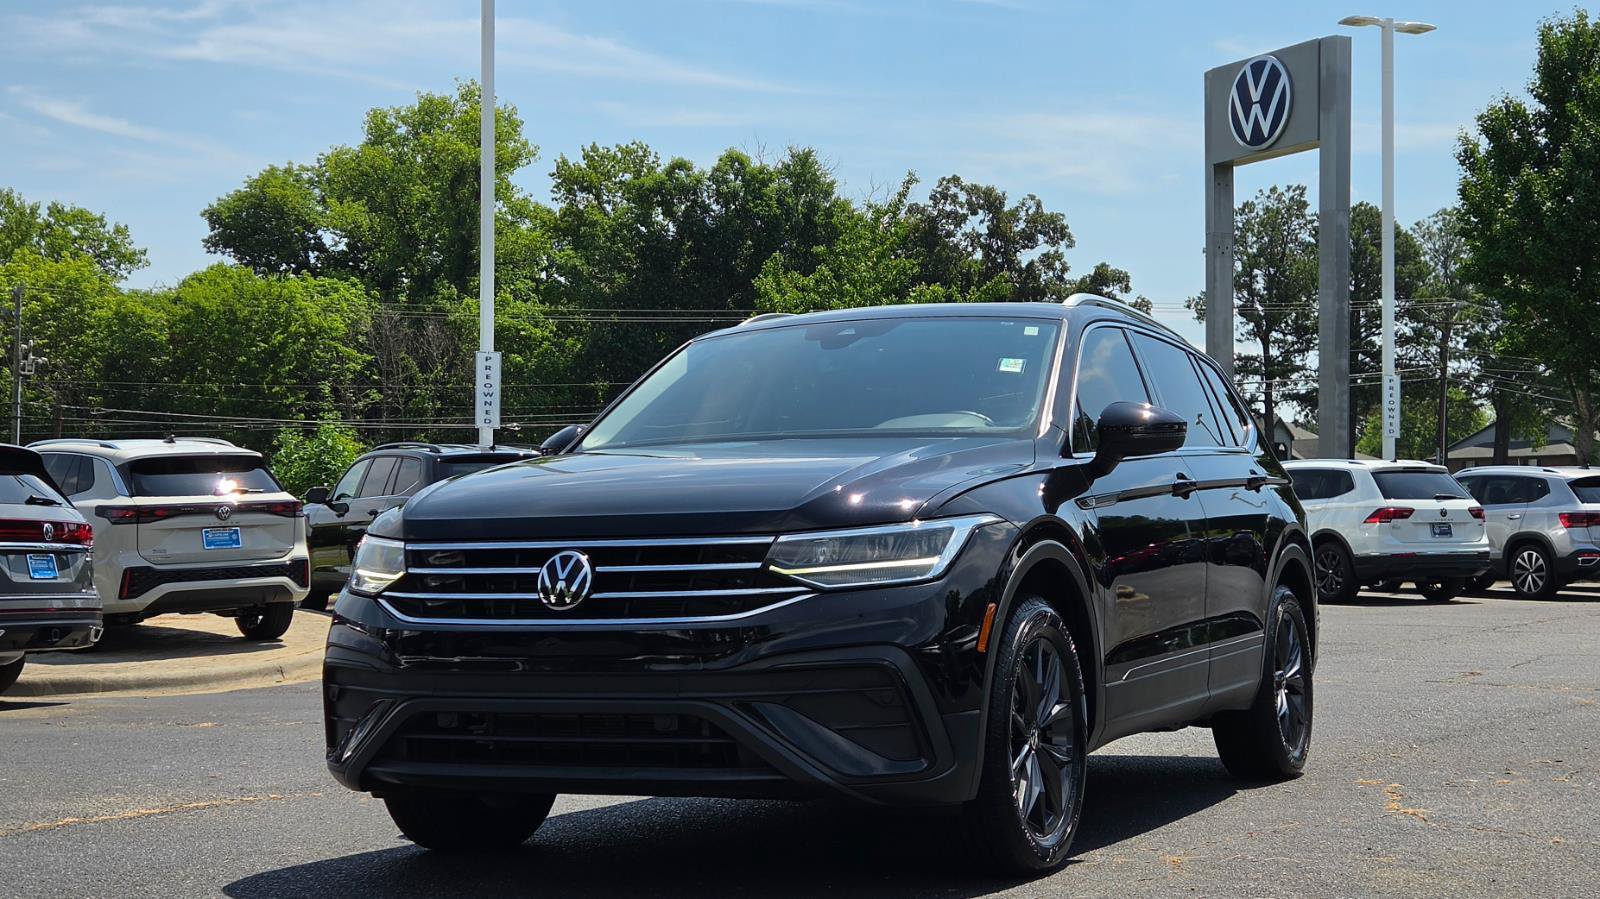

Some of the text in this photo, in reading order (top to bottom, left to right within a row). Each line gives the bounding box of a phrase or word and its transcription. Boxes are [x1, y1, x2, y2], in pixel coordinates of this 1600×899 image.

[1231, 58, 1288, 142] VW
[483, 356, 494, 424] PREOWNED
[539, 552, 590, 607] VW
